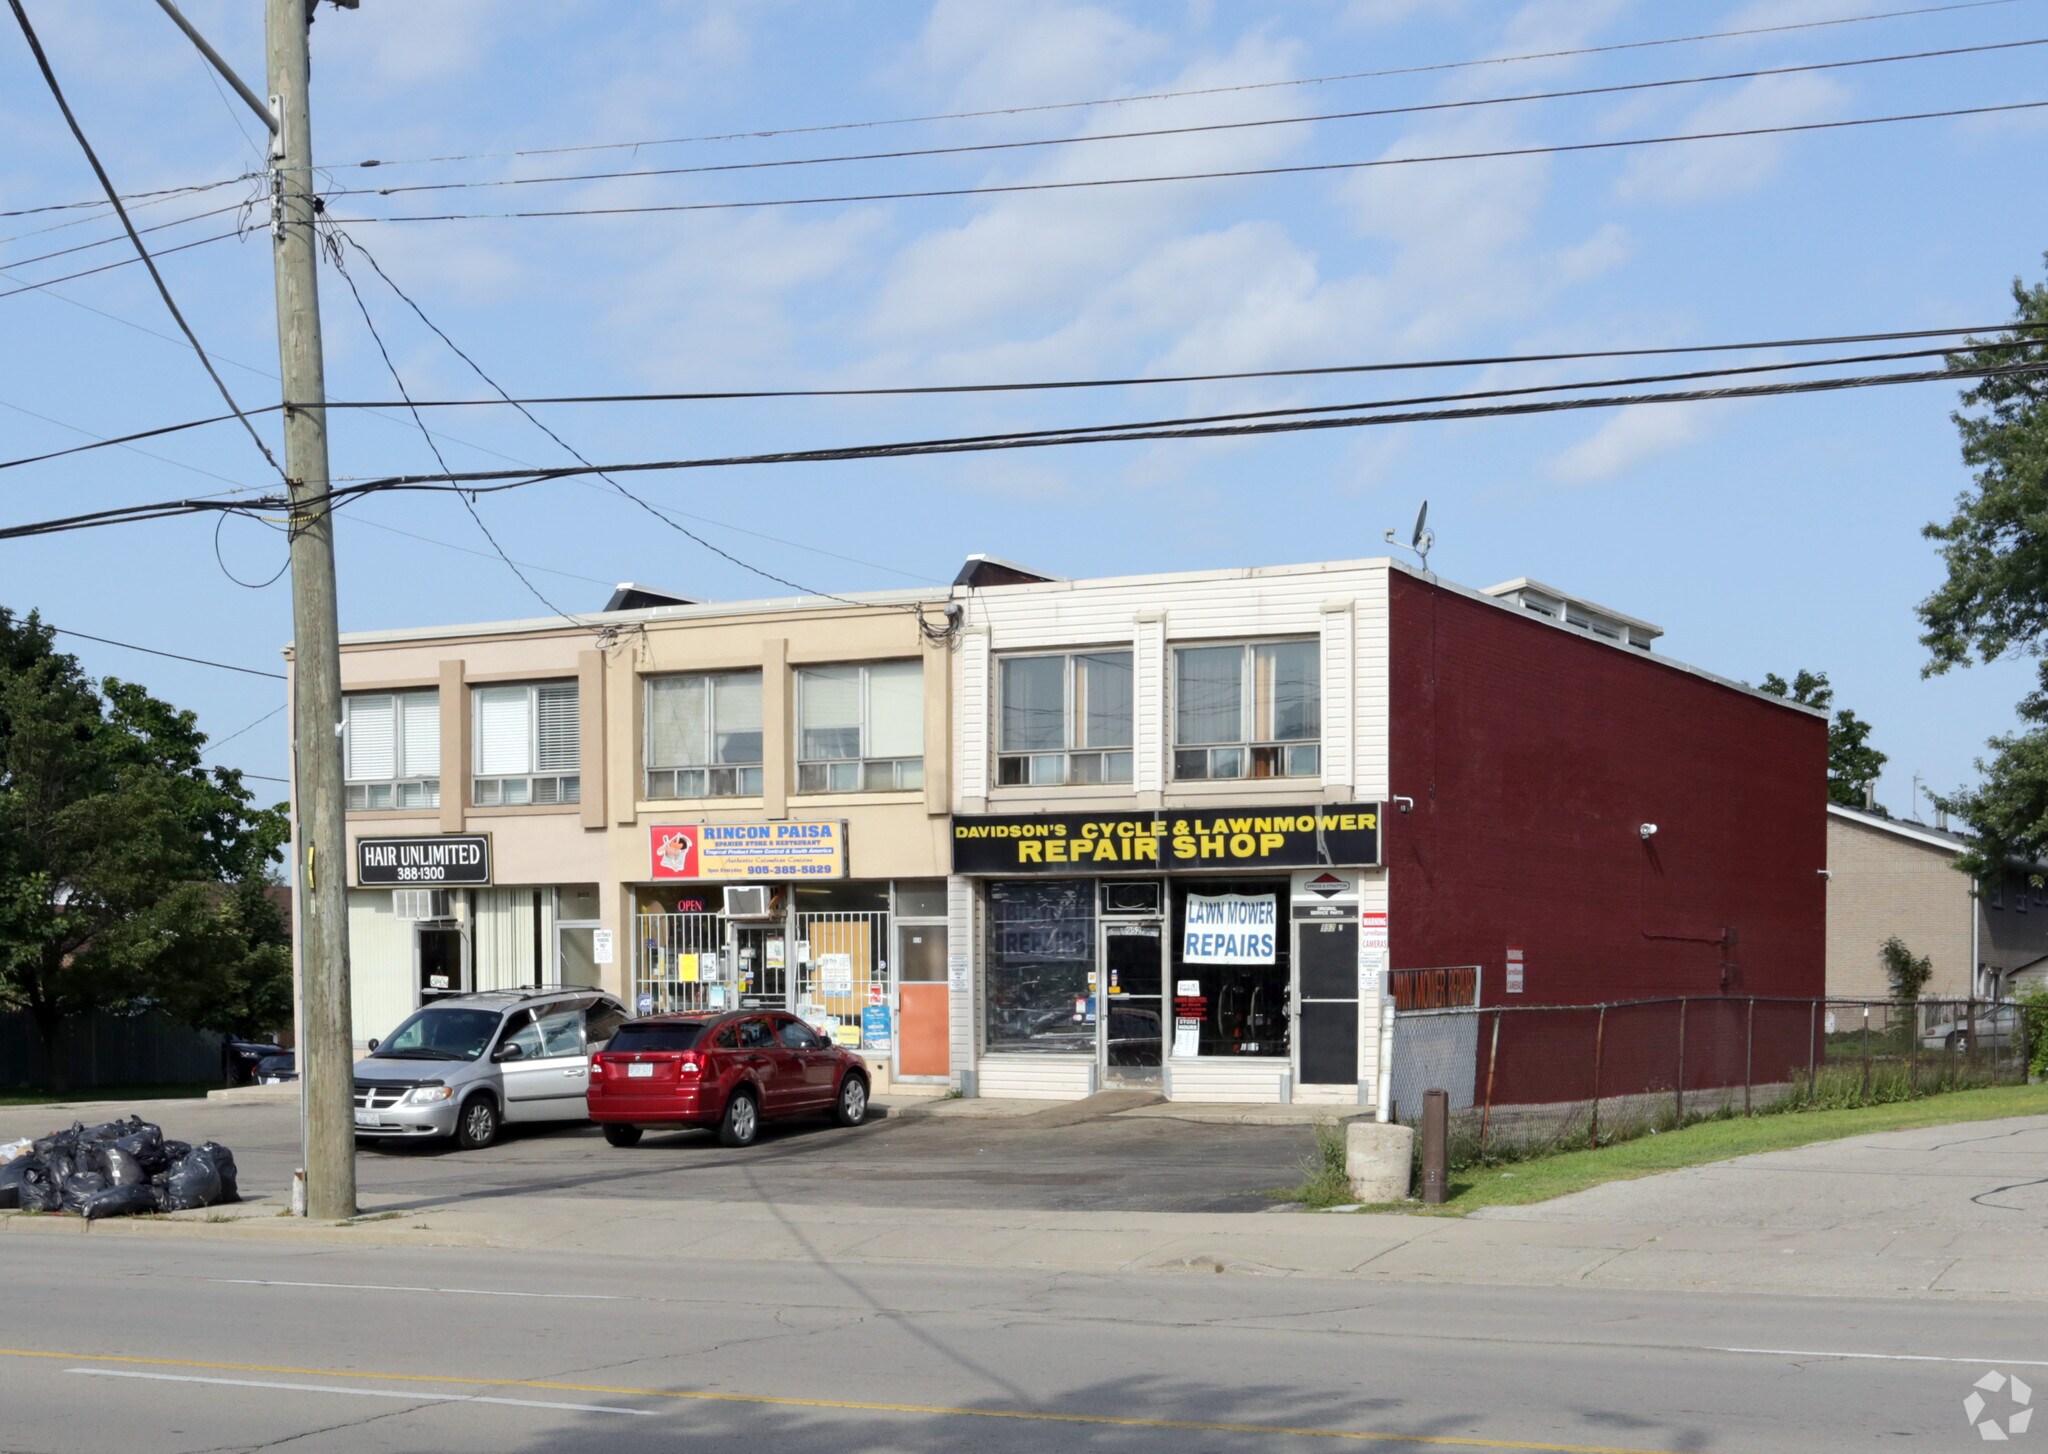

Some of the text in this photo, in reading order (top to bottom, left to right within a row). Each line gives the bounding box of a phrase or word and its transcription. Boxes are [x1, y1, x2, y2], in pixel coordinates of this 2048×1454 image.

[704, 824, 832, 840] RINCON PAISA
[956, 813, 1377, 840] DAVIDSON'S CYCLE & LAWNMOWER
[365, 844, 480, 866] HAIR UNLIMITED
[1018, 832, 1285, 863] REPAIR SHOP
[398, 866, 444, 880] 388-1300
[747, 865, 832, 874] 905-385-5829
[678, 900, 703, 912] OPEN
[1188, 900, 1273, 924] LAWN MOWER
[1186, 932, 1273, 957] REPAIRS
[1363, 940, 1387, 948] CAMERAS
[432, 978, 448, 986] OPEN
